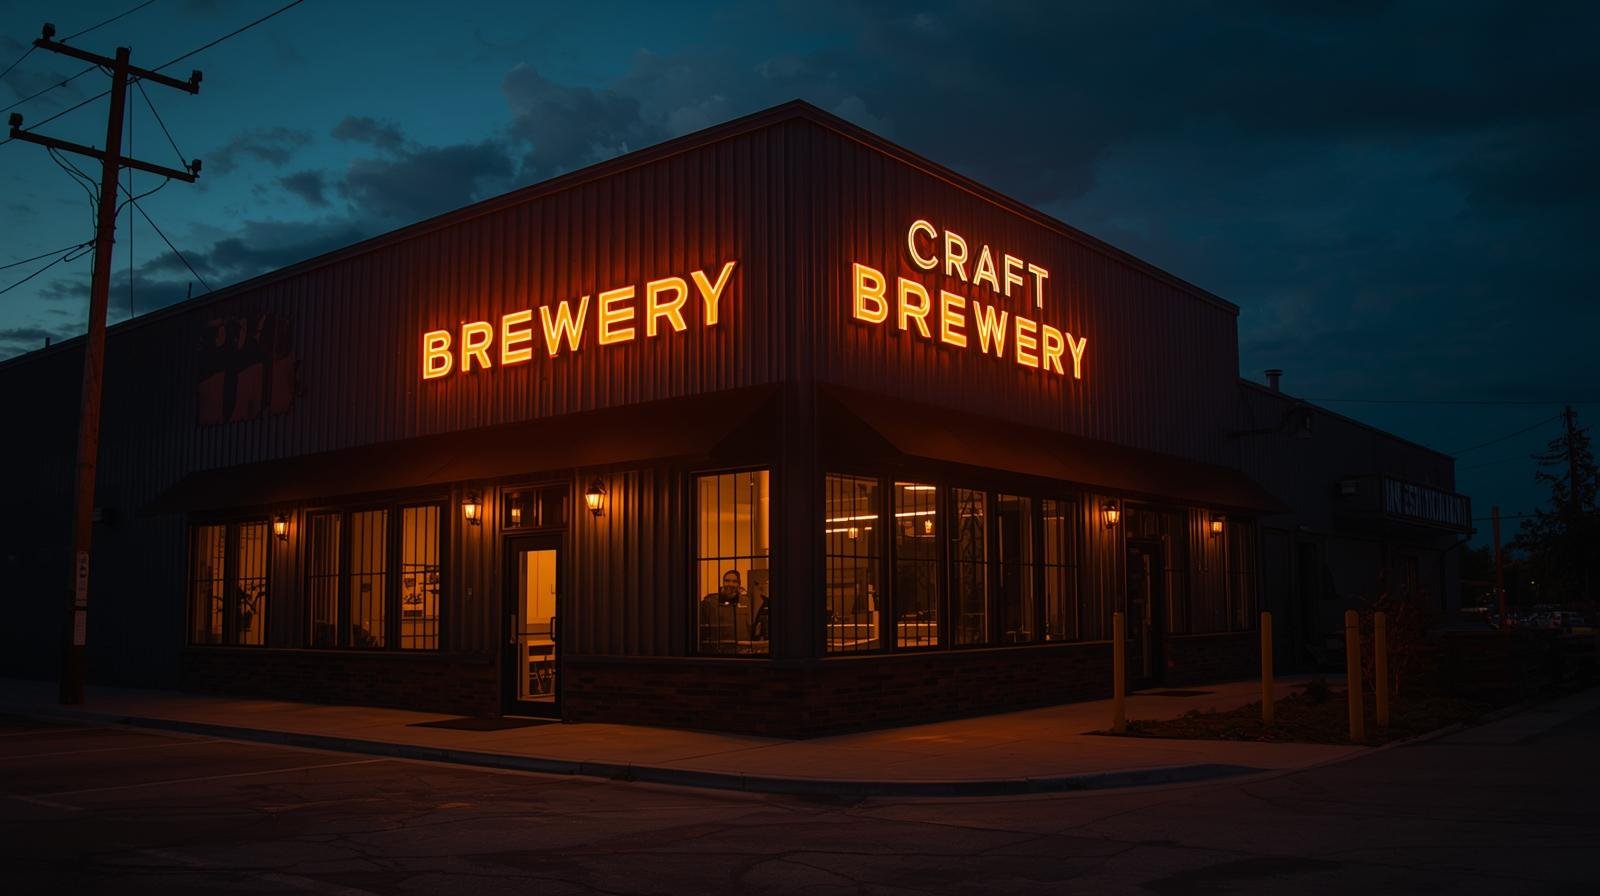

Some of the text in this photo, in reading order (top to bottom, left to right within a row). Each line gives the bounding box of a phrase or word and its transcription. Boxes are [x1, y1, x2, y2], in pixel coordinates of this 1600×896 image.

[421, 260, 737, 381] BREWERY
[851, 261, 1089, 380] BREWERY
[907, 218, 1050, 310] CRAFT
